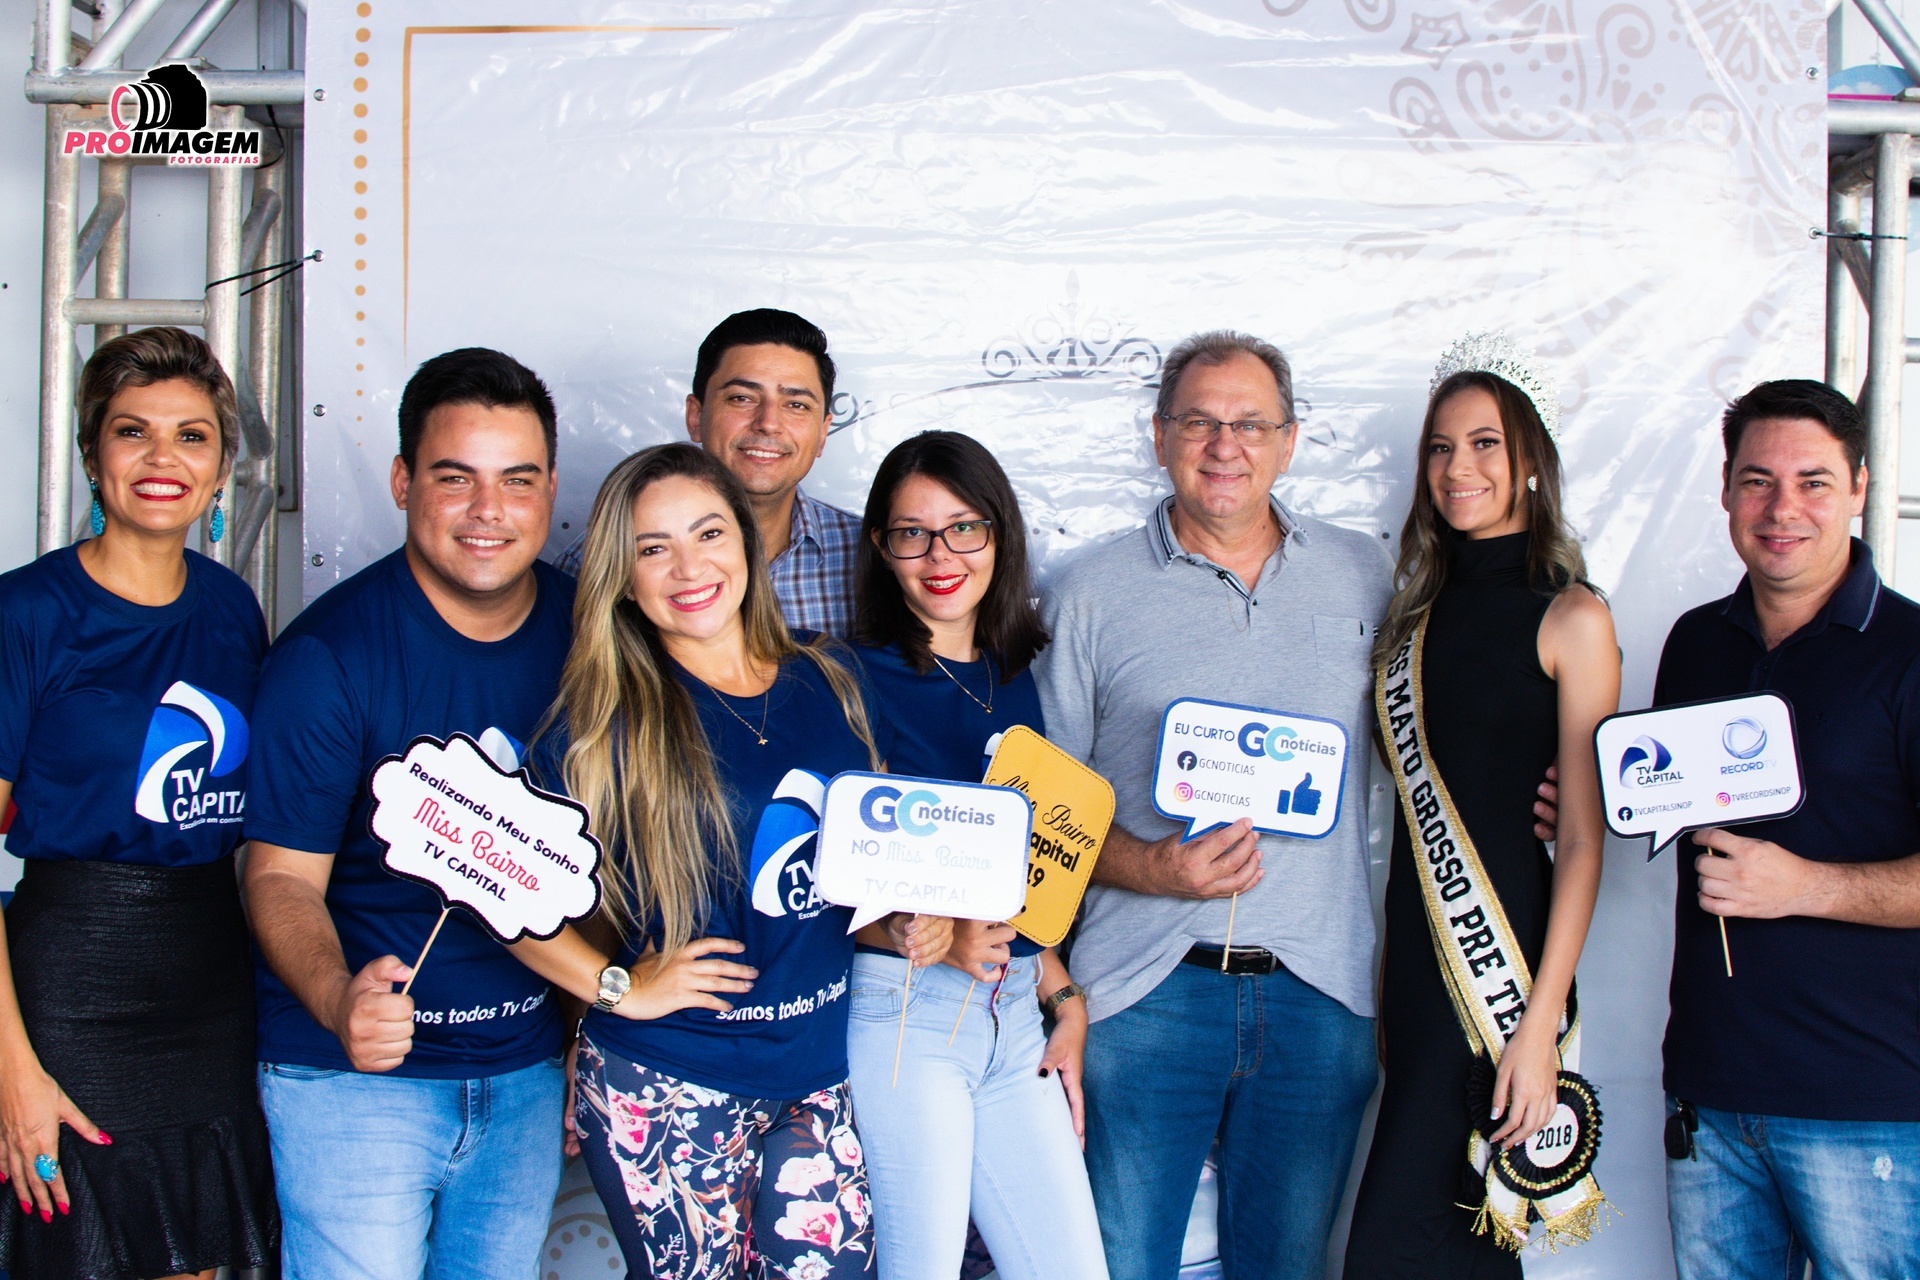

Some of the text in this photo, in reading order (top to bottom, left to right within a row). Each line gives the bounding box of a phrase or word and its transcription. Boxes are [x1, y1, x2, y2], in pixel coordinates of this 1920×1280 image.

[1174, 722, 1190, 735] EU
[1193, 725, 1235, 742] CURTO
[1199, 758, 1255, 776] GCNOTICIAS
[1636, 766, 1651, 775] TV
[1637, 771, 1684, 786] CAPITAL
[171, 767, 205, 796] TV
[1731, 786, 1792, 802] TVRECORDSINOP
[172, 791, 246, 822] CAPITA
[1194, 790, 1250, 807] GCNOTICIAS
[1634, 801, 1693, 817] TVCAPITALSINOP
[409, 762, 580, 875] Realizando Meu Sonho
[1042, 804, 1097, 850] Bairro
[1385, 678, 1423, 778] MATO
[1411, 779, 1472, 903] GROSSO
[1450, 904, 1507, 978] PRE
[413, 797, 540, 892] Miss Bairro
[851, 839, 992, 871] NO Miss Bairro
[1030, 831, 1080, 873] apital
[423, 840, 506, 902] TV CAPITAL
[865, 878, 969, 904] TV CAPITAL
[448, 1005, 497, 1024] todos
[501, 1001, 520, 1017] Tv
[778, 995, 814, 1020] todos
[816, 989, 827, 1009] Tv
[1535, 1124, 1572, 1151] 2018
